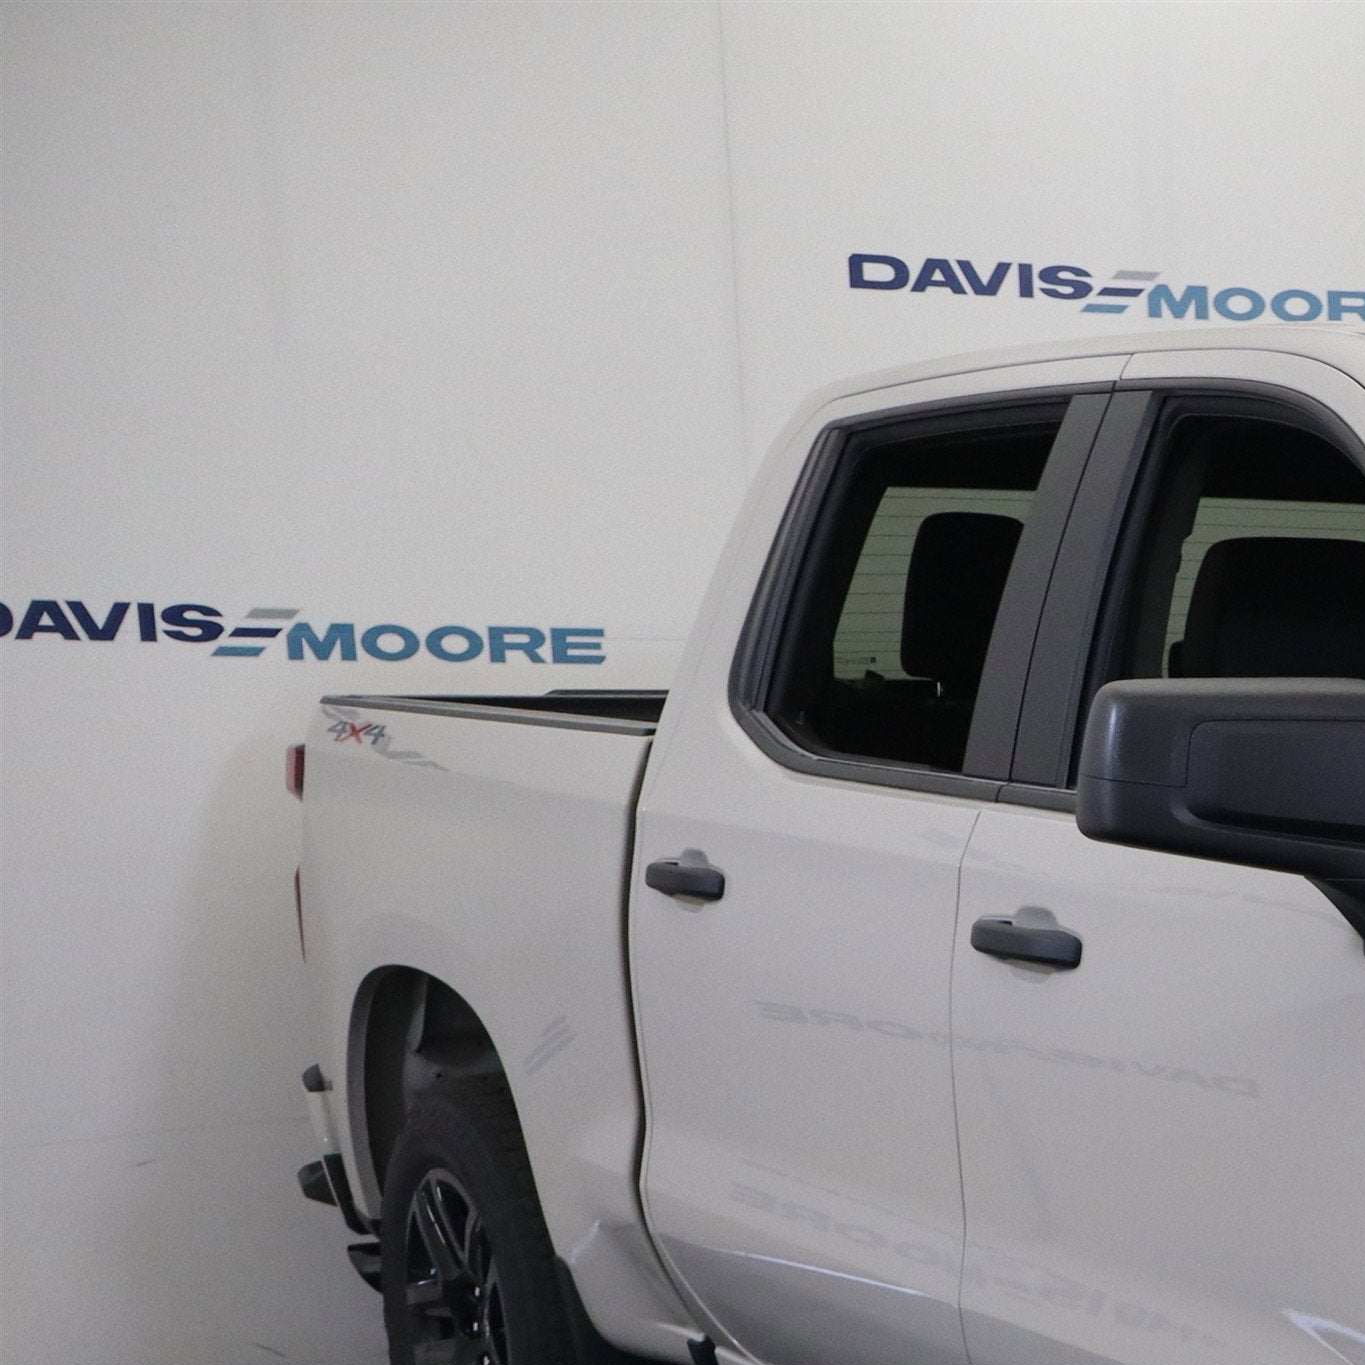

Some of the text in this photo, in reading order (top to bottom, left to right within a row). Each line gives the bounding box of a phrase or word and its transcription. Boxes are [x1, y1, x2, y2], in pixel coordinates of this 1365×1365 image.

[848, 253, 1094, 299] DAVIS
[0, 599, 607, 665] AVIS MOORE
